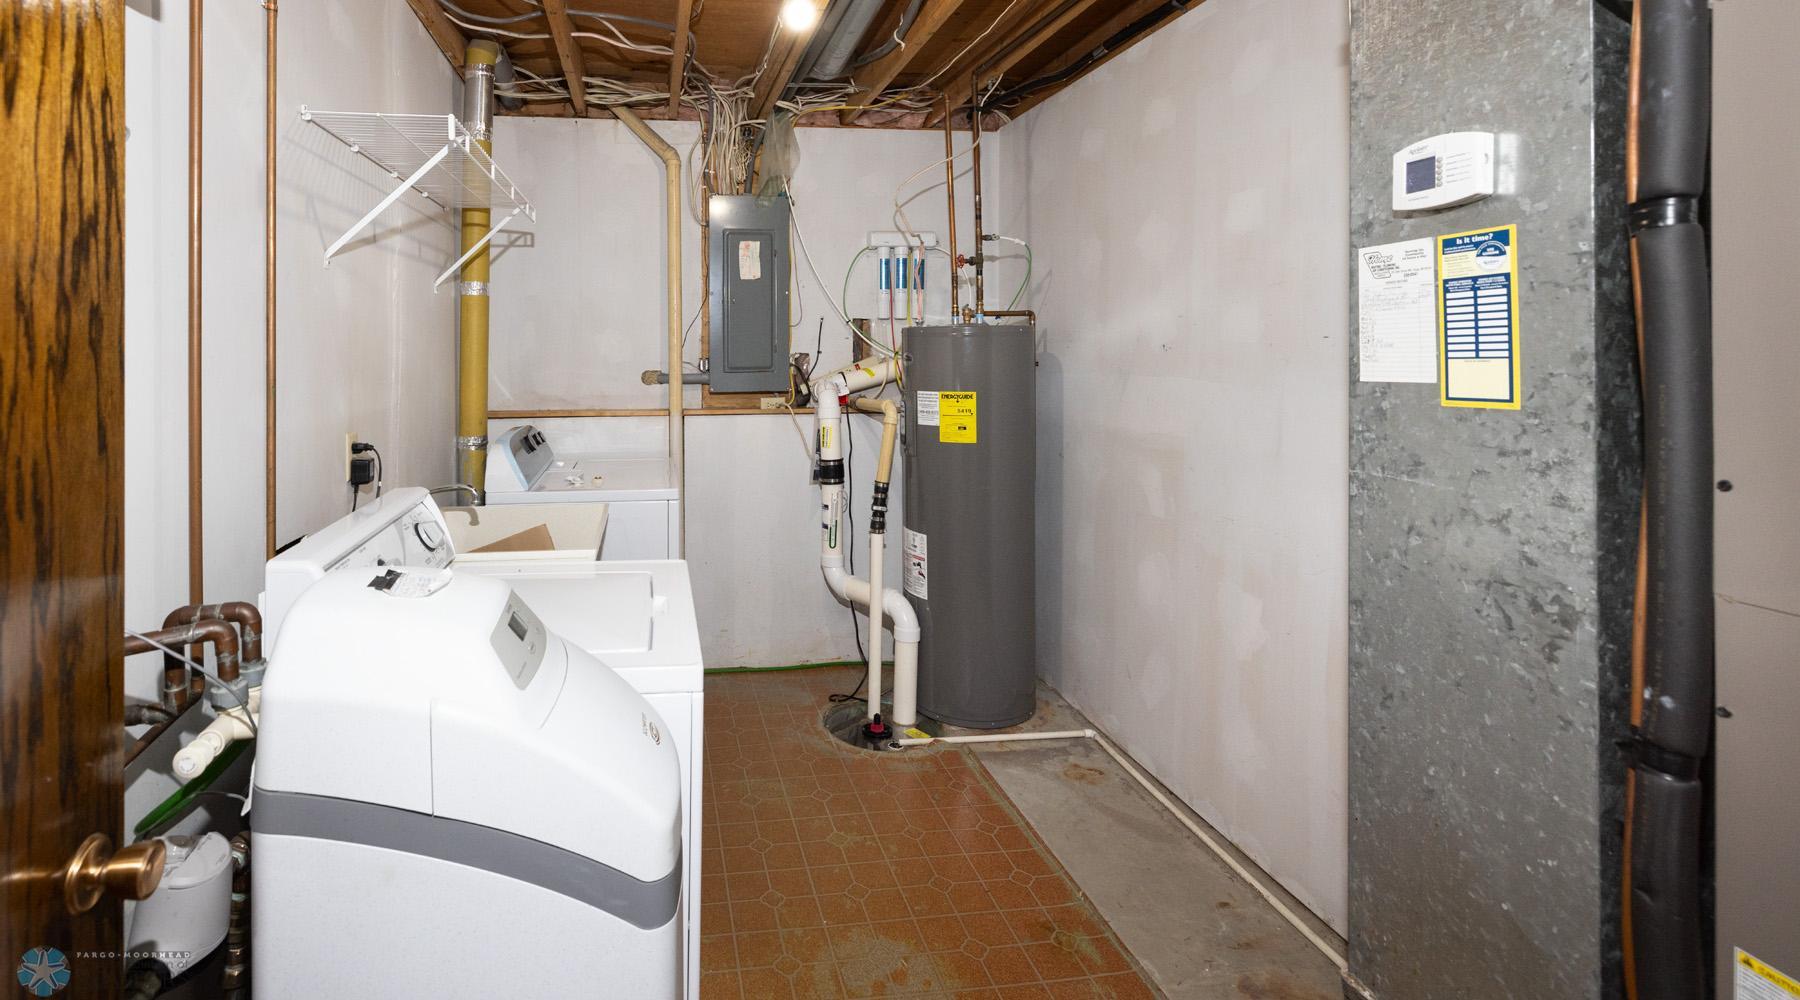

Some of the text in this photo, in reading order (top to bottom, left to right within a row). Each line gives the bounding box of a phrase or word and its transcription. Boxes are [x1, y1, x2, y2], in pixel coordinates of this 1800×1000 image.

[1464, 236, 1470, 244] it
[1471, 233, 1493, 243] time?
[1758, 966, 1800, 994] CAUTIO
